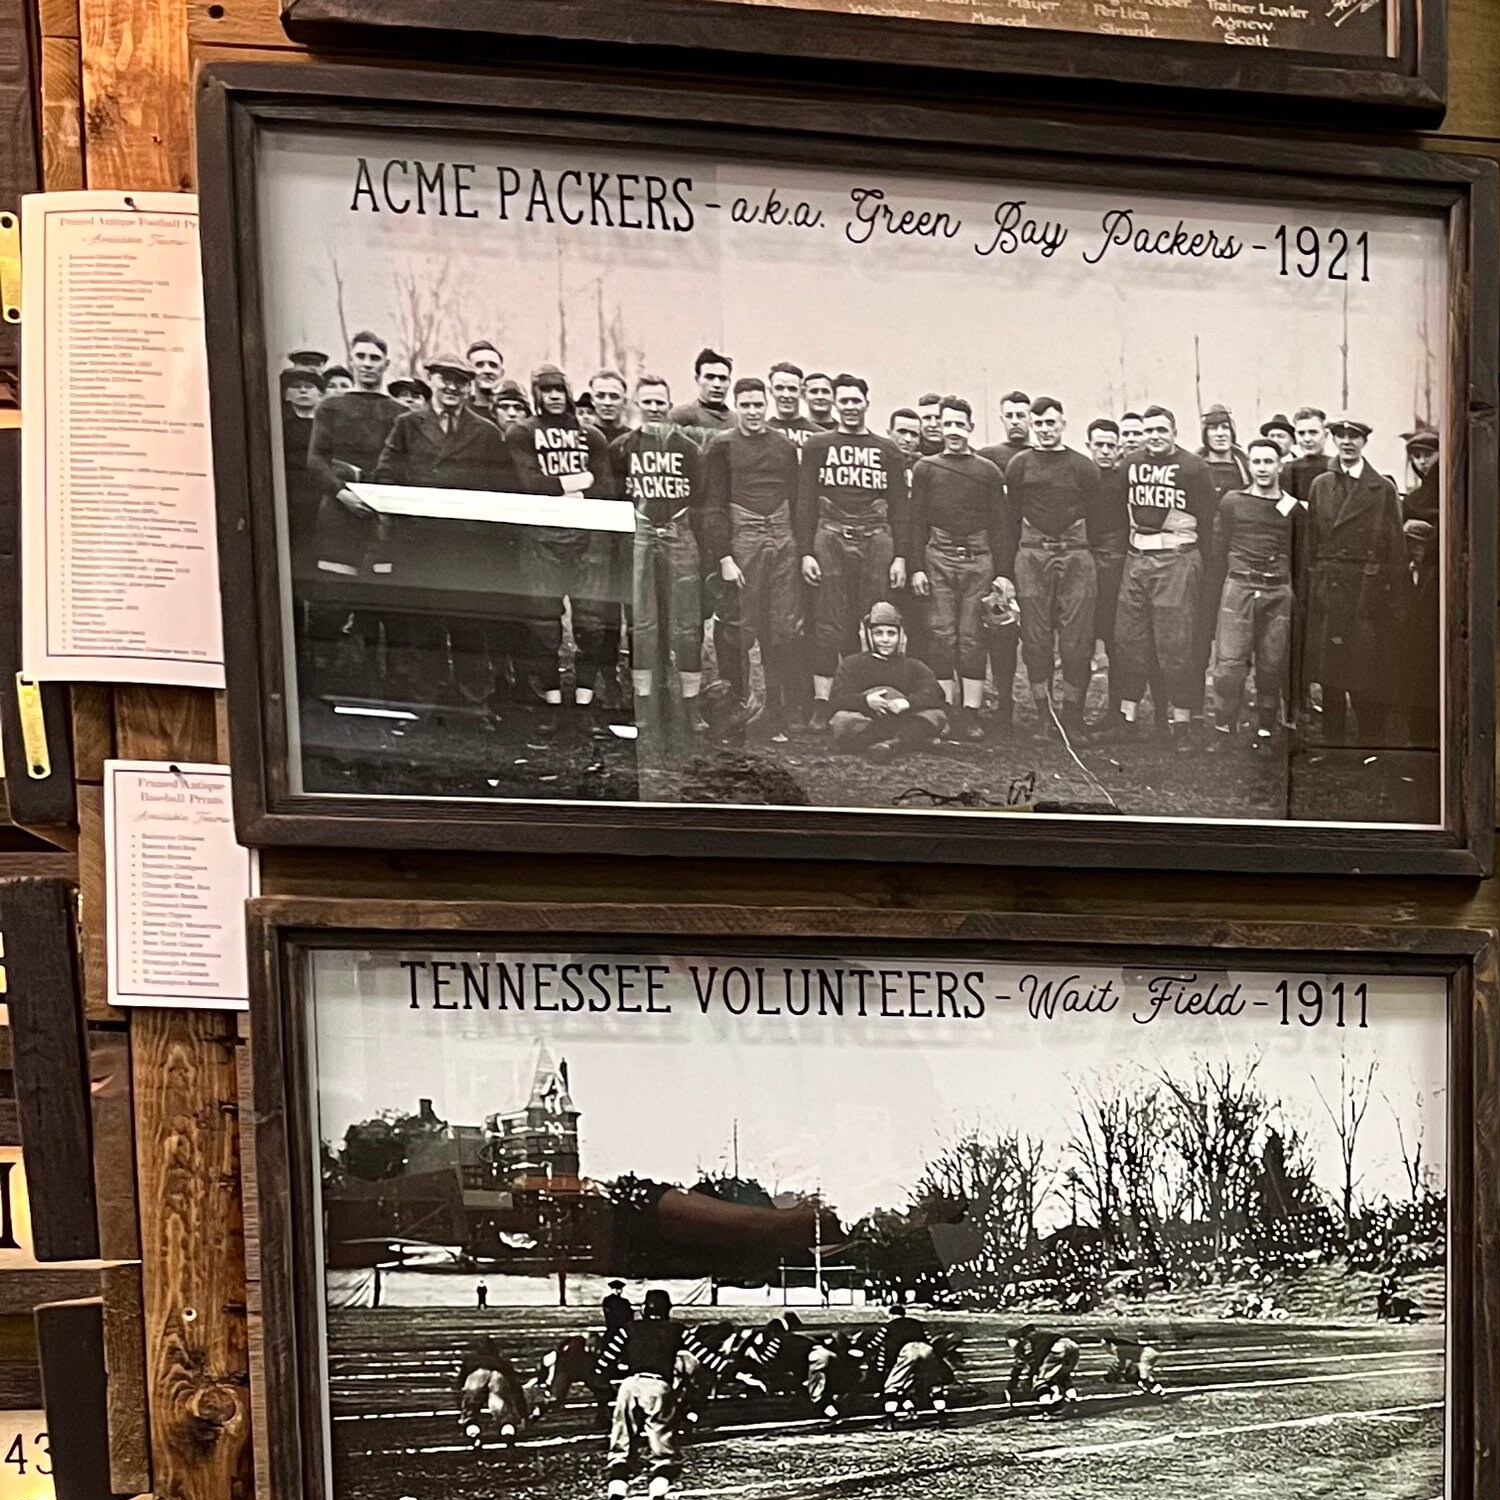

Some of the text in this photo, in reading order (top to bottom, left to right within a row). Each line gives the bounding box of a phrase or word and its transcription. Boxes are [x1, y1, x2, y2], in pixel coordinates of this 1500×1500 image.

[1207, 0, 1256, 14] Trainer
[1259, 6, 1310, 20] Lawler
[1224, 32, 1270, 48] Scott
[349, 158, 480, 219] ACME
[496, 166, 695, 233] PACKERS
[845, 188, 962, 244] Green
[974, 200, 1068, 259] Bay
[1082, 208, 1243, 264] Packers
[1274, 223, 1372, 282] 1921
[630, 451, 685, 475] ACME
[825, 445, 882, 469] ACME
[1128, 463, 1180, 487] ACME
[400, 960, 1370, 1028] TENNESSEE VOLUNTEERS Wait Field 1911
